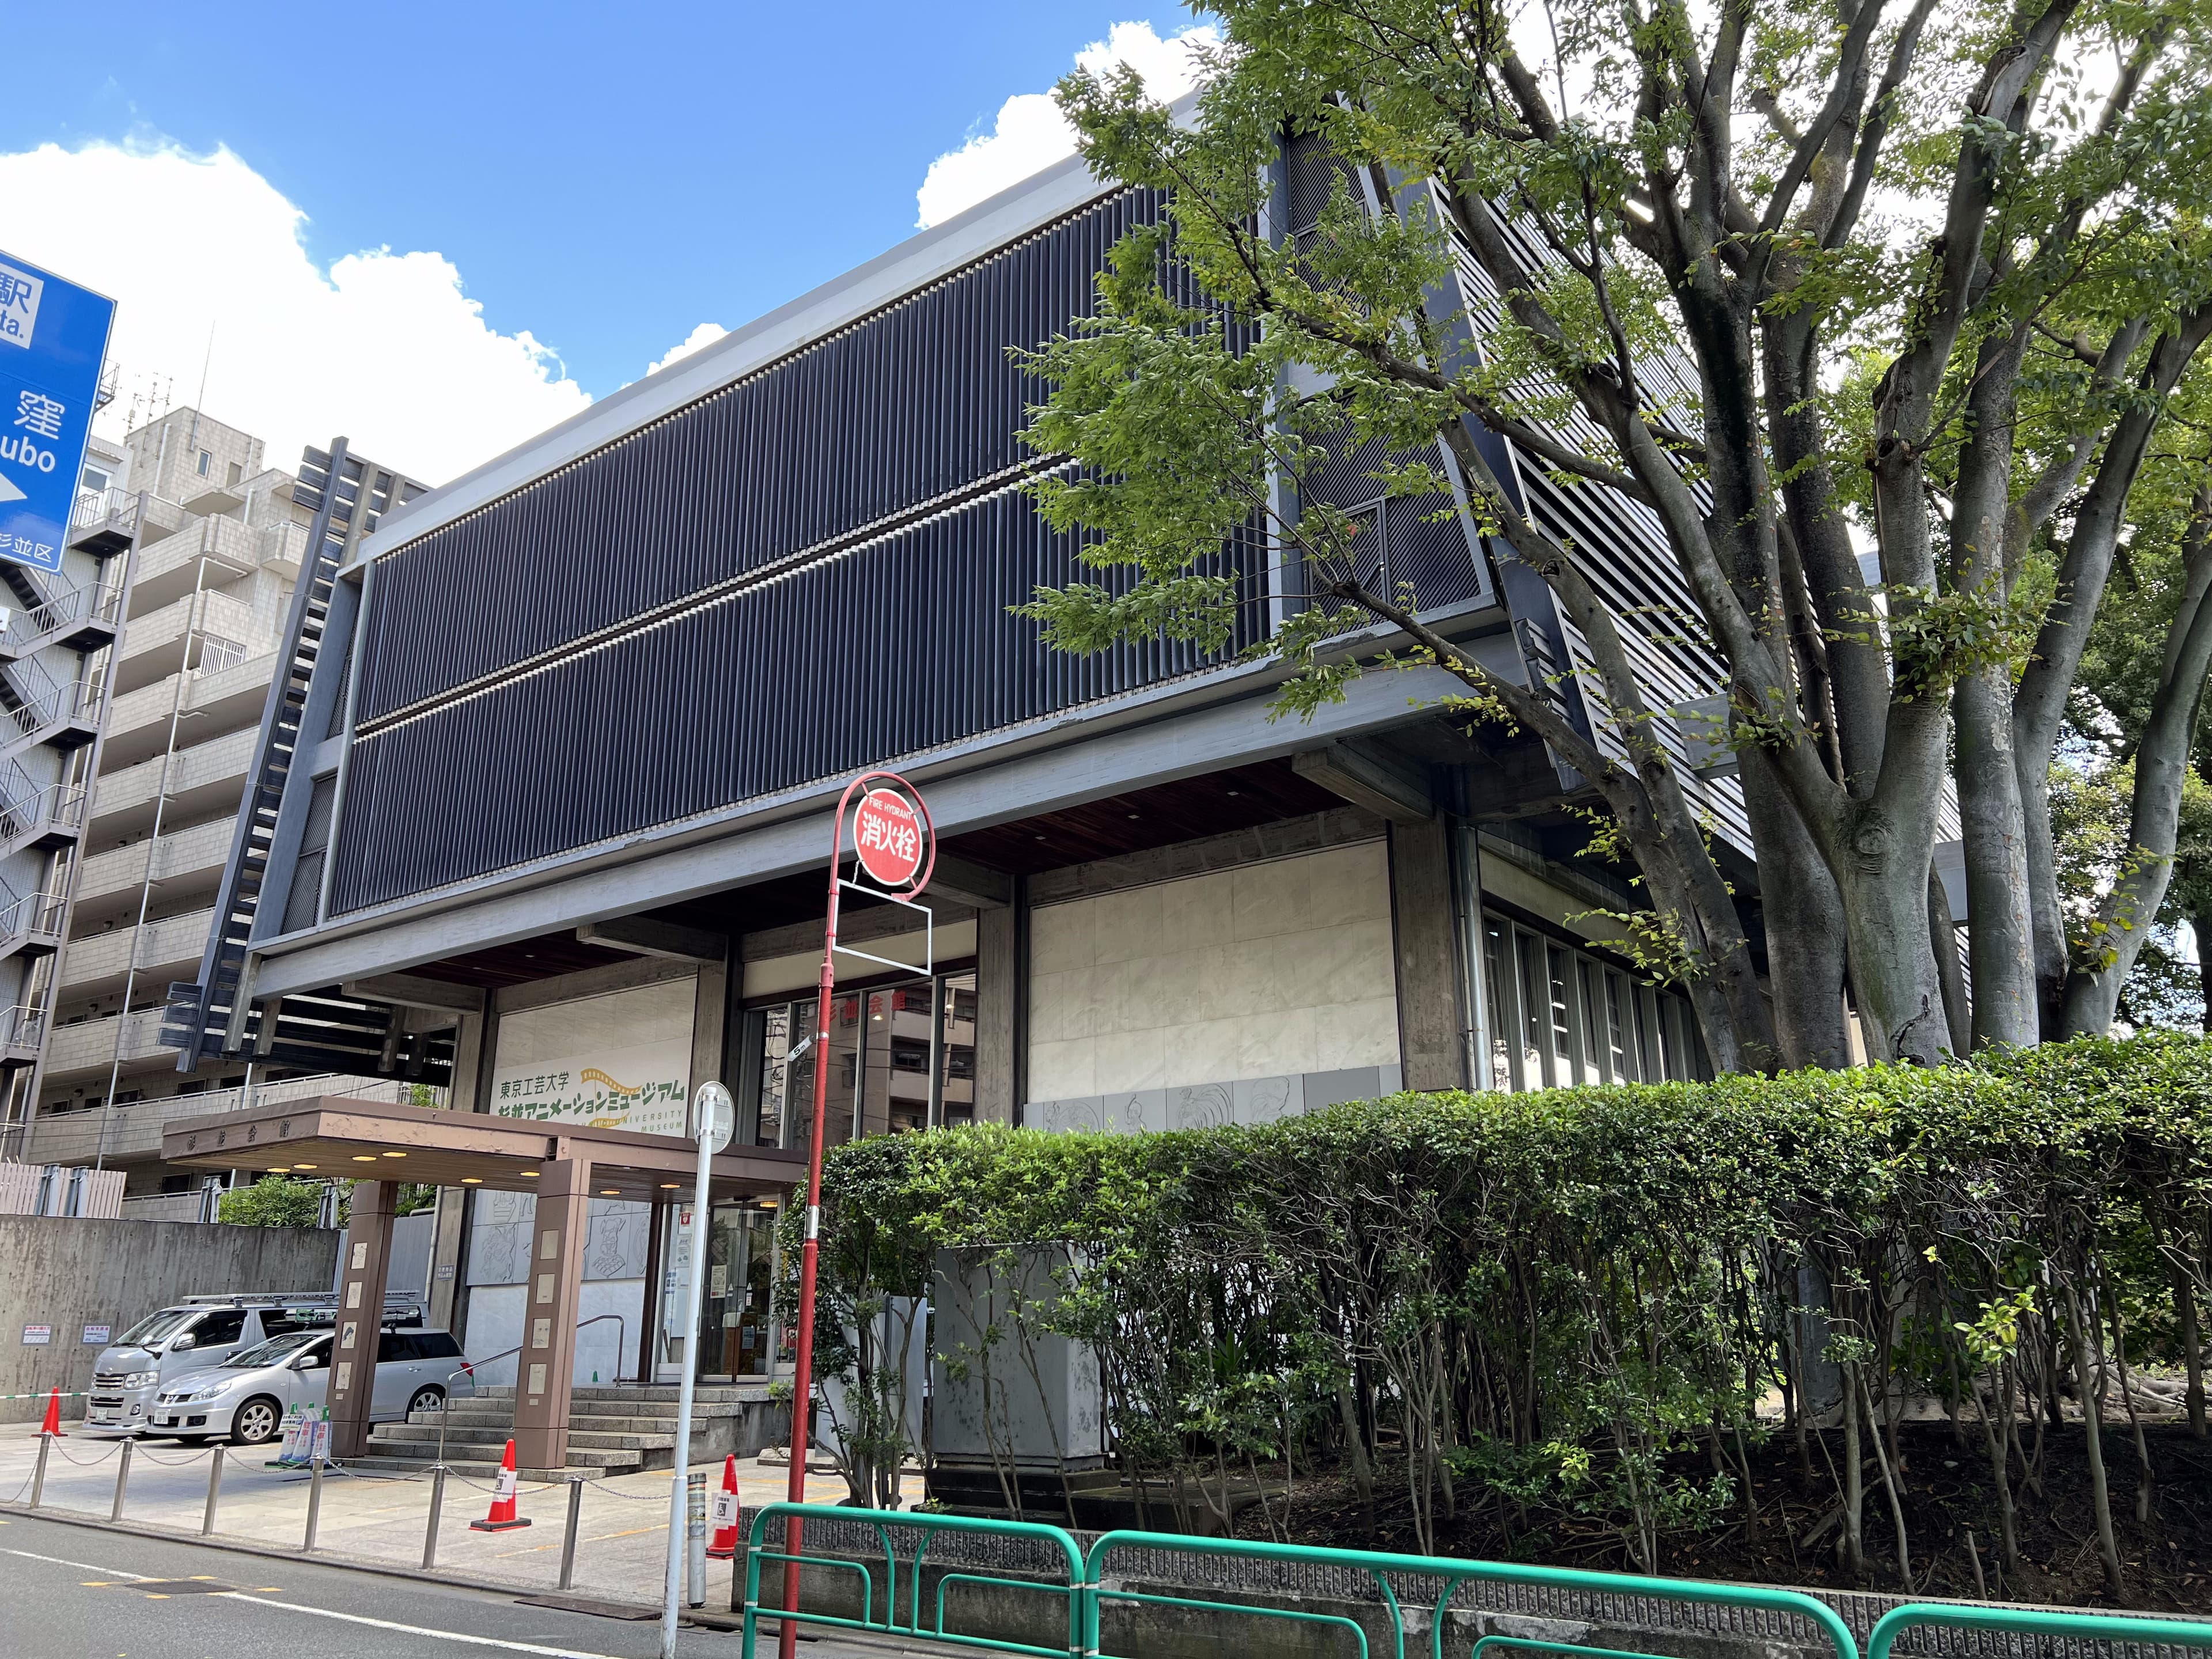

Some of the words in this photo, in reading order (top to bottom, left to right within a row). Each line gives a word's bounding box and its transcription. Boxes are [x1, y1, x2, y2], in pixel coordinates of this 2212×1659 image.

[0, 272, 32, 313] 駅
[0, 309, 24, 339] ta.
[14, 390, 65, 440] 窪
[0, 435, 55, 472] ubo
[869, 797, 882, 810] FIRE
[884, 802, 912, 821] HYDRANT
[861, 811, 916, 862] 消火栓
[794, 1045, 806, 1055] 5m
[499, 1071, 569, 1099] 東京工芸大学
[641, 1122, 682, 1132] MUSEUM
